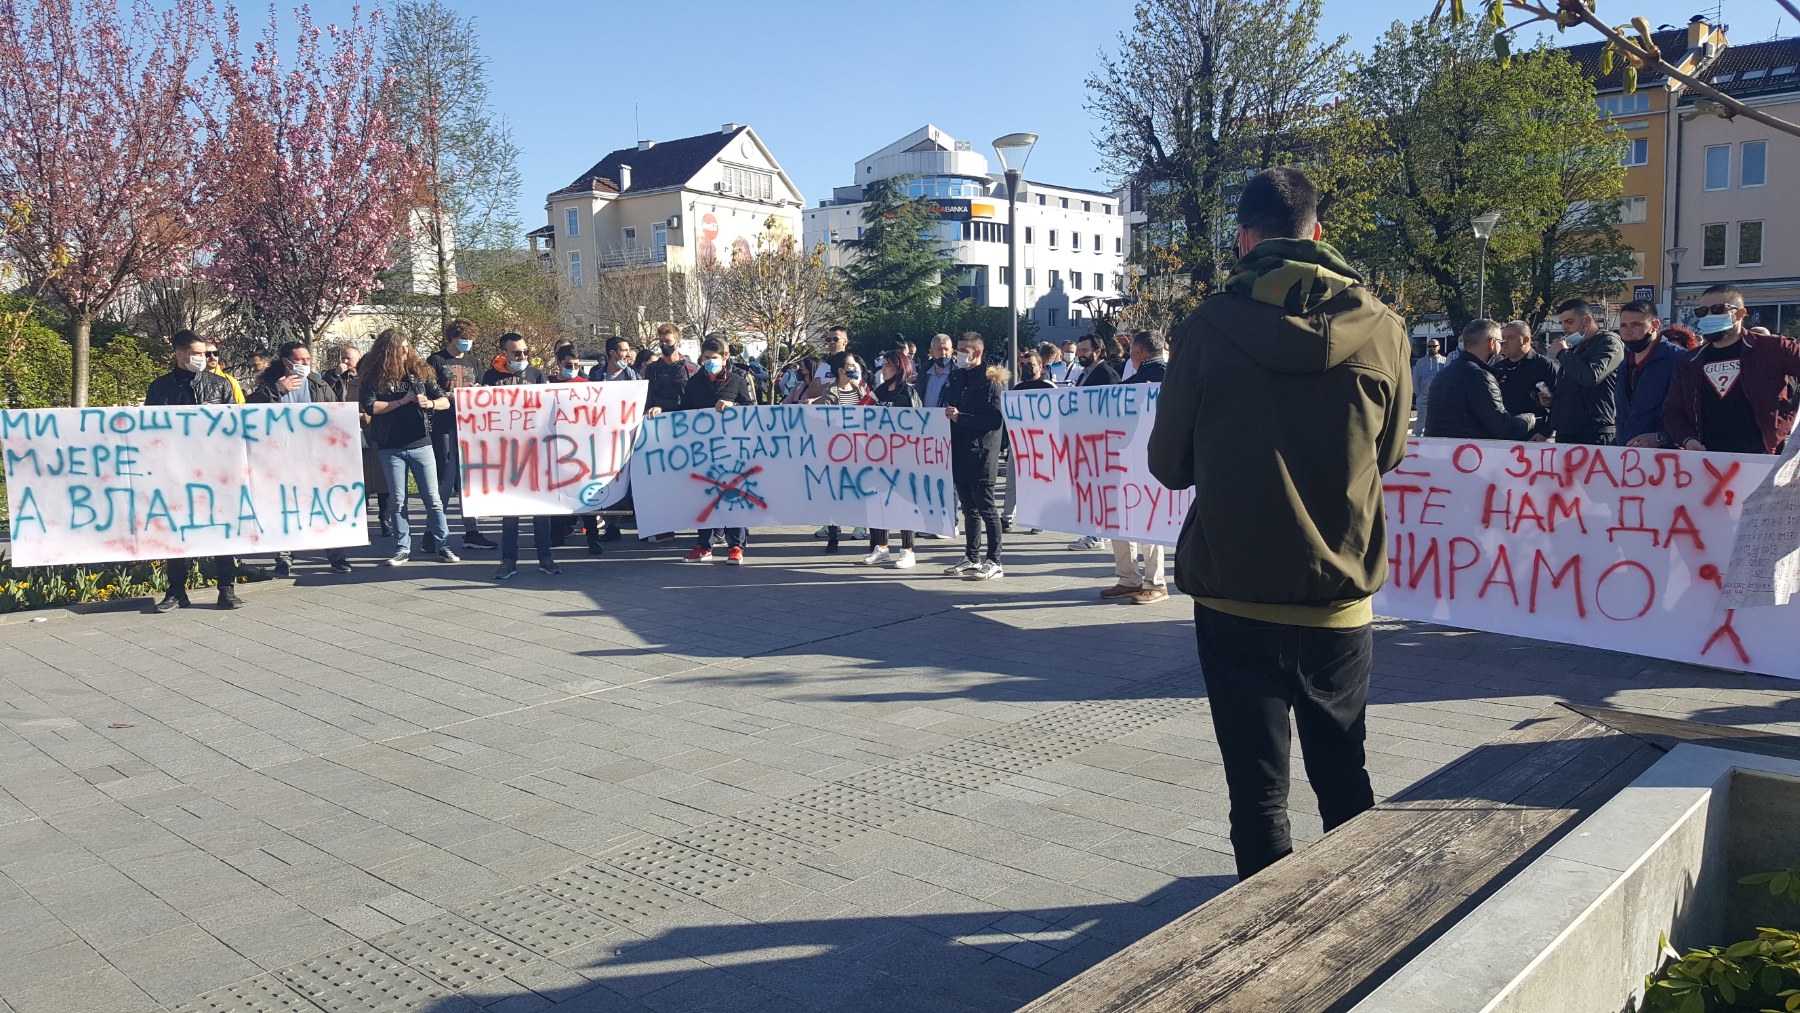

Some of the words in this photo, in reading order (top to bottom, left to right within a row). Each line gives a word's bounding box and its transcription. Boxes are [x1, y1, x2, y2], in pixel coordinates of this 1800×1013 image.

[1705, 361, 1740, 373] GUESS
[457, 409, 537, 434] МЈЕРЕ
[554, 405, 607, 427] АЛИ
[621, 399, 637, 424] И
[815, 405, 931, 434] ТЕРАСУ
[1004, 393, 1051, 422] ШТО
[1058, 390, 1079, 416] СЕ
[1082, 386, 1138, 418] ТИЧЕ
[1, 408, 59, 440] МИ
[79, 405, 329, 442] ПОШТУЈЕМО
[827, 432, 951, 470] ОГОРЧЕНУ
[1009, 427, 1129, 486] НЕМАТЕ
[1452, 443, 1484, 474] О
[12, 486, 47, 540] А
[68, 482, 264, 542] ВЛАДА
[279, 481, 366, 534] НАС?
[1482, 482, 1588, 535] НАМ
[1606, 495, 1705, 551] ДА
[1387, 530, 1656, 621] НИРАМО
